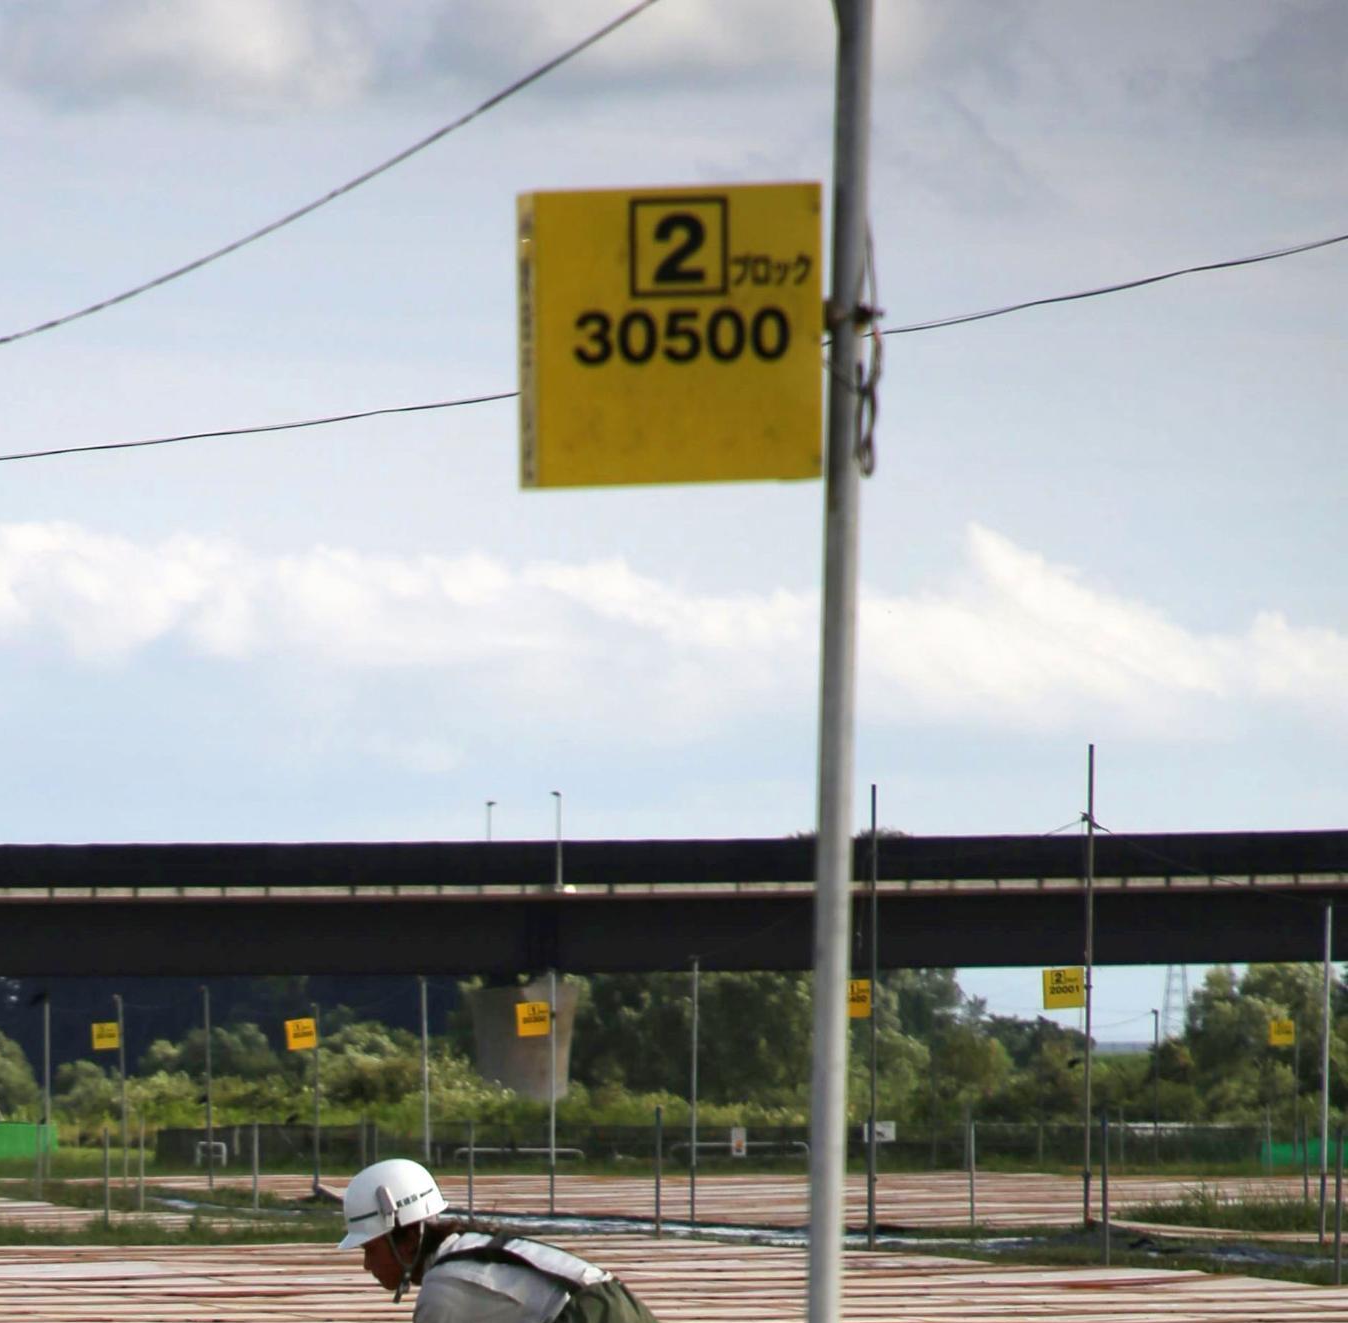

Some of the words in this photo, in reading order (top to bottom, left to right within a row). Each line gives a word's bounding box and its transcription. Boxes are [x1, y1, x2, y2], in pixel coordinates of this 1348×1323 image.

[653, 212, 707, 284] 2
[731, 254, 813, 287] ブロック
[572, 305, 791, 368] 30500
[1049, 984, 1080, 995] 20001
[1054, 972, 1063, 984] 2
